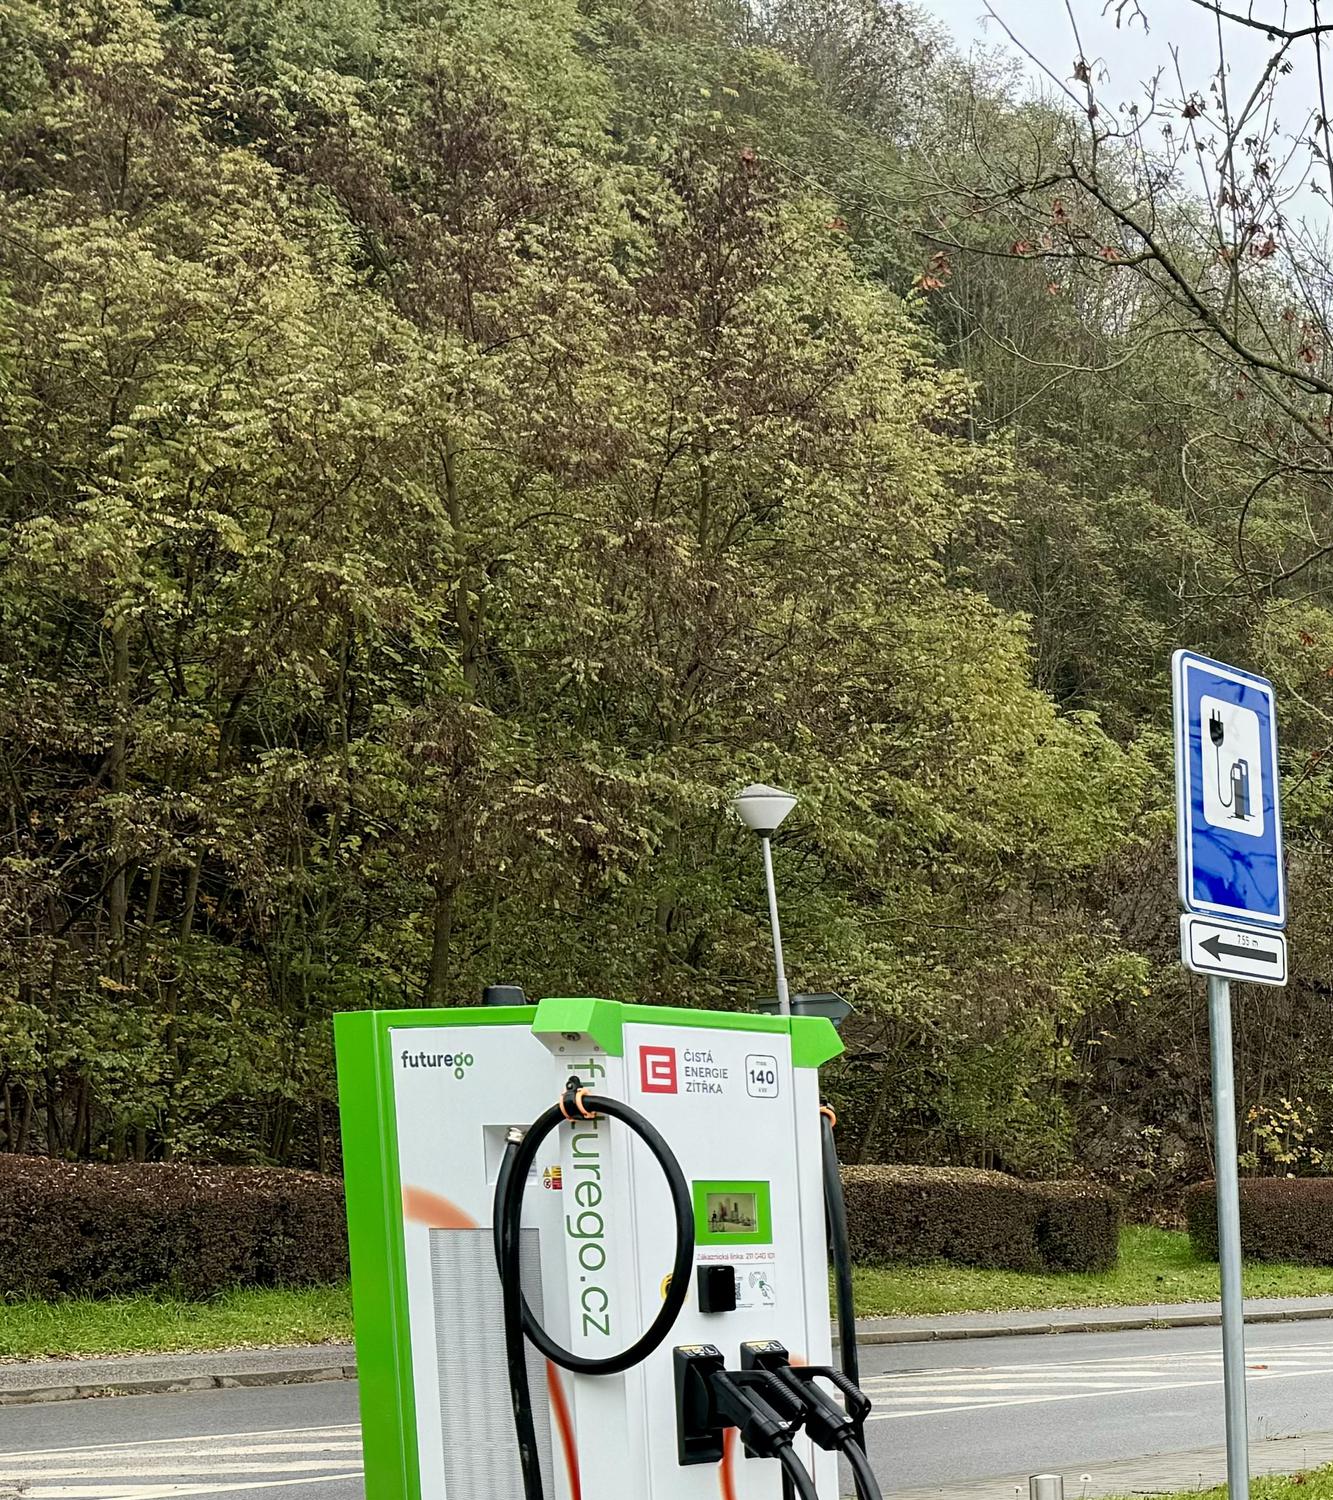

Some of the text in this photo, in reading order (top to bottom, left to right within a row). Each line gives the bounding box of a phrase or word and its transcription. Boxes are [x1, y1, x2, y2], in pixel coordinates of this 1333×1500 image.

[684, 1048, 714, 1064] ČISTÁ
[401, 1050, 474, 1080] futurego
[684, 1066, 729, 1079] ENERGIE
[750, 1069, 775, 1085] 140
[685, 1080, 723, 1094] ZÍTŘKA
